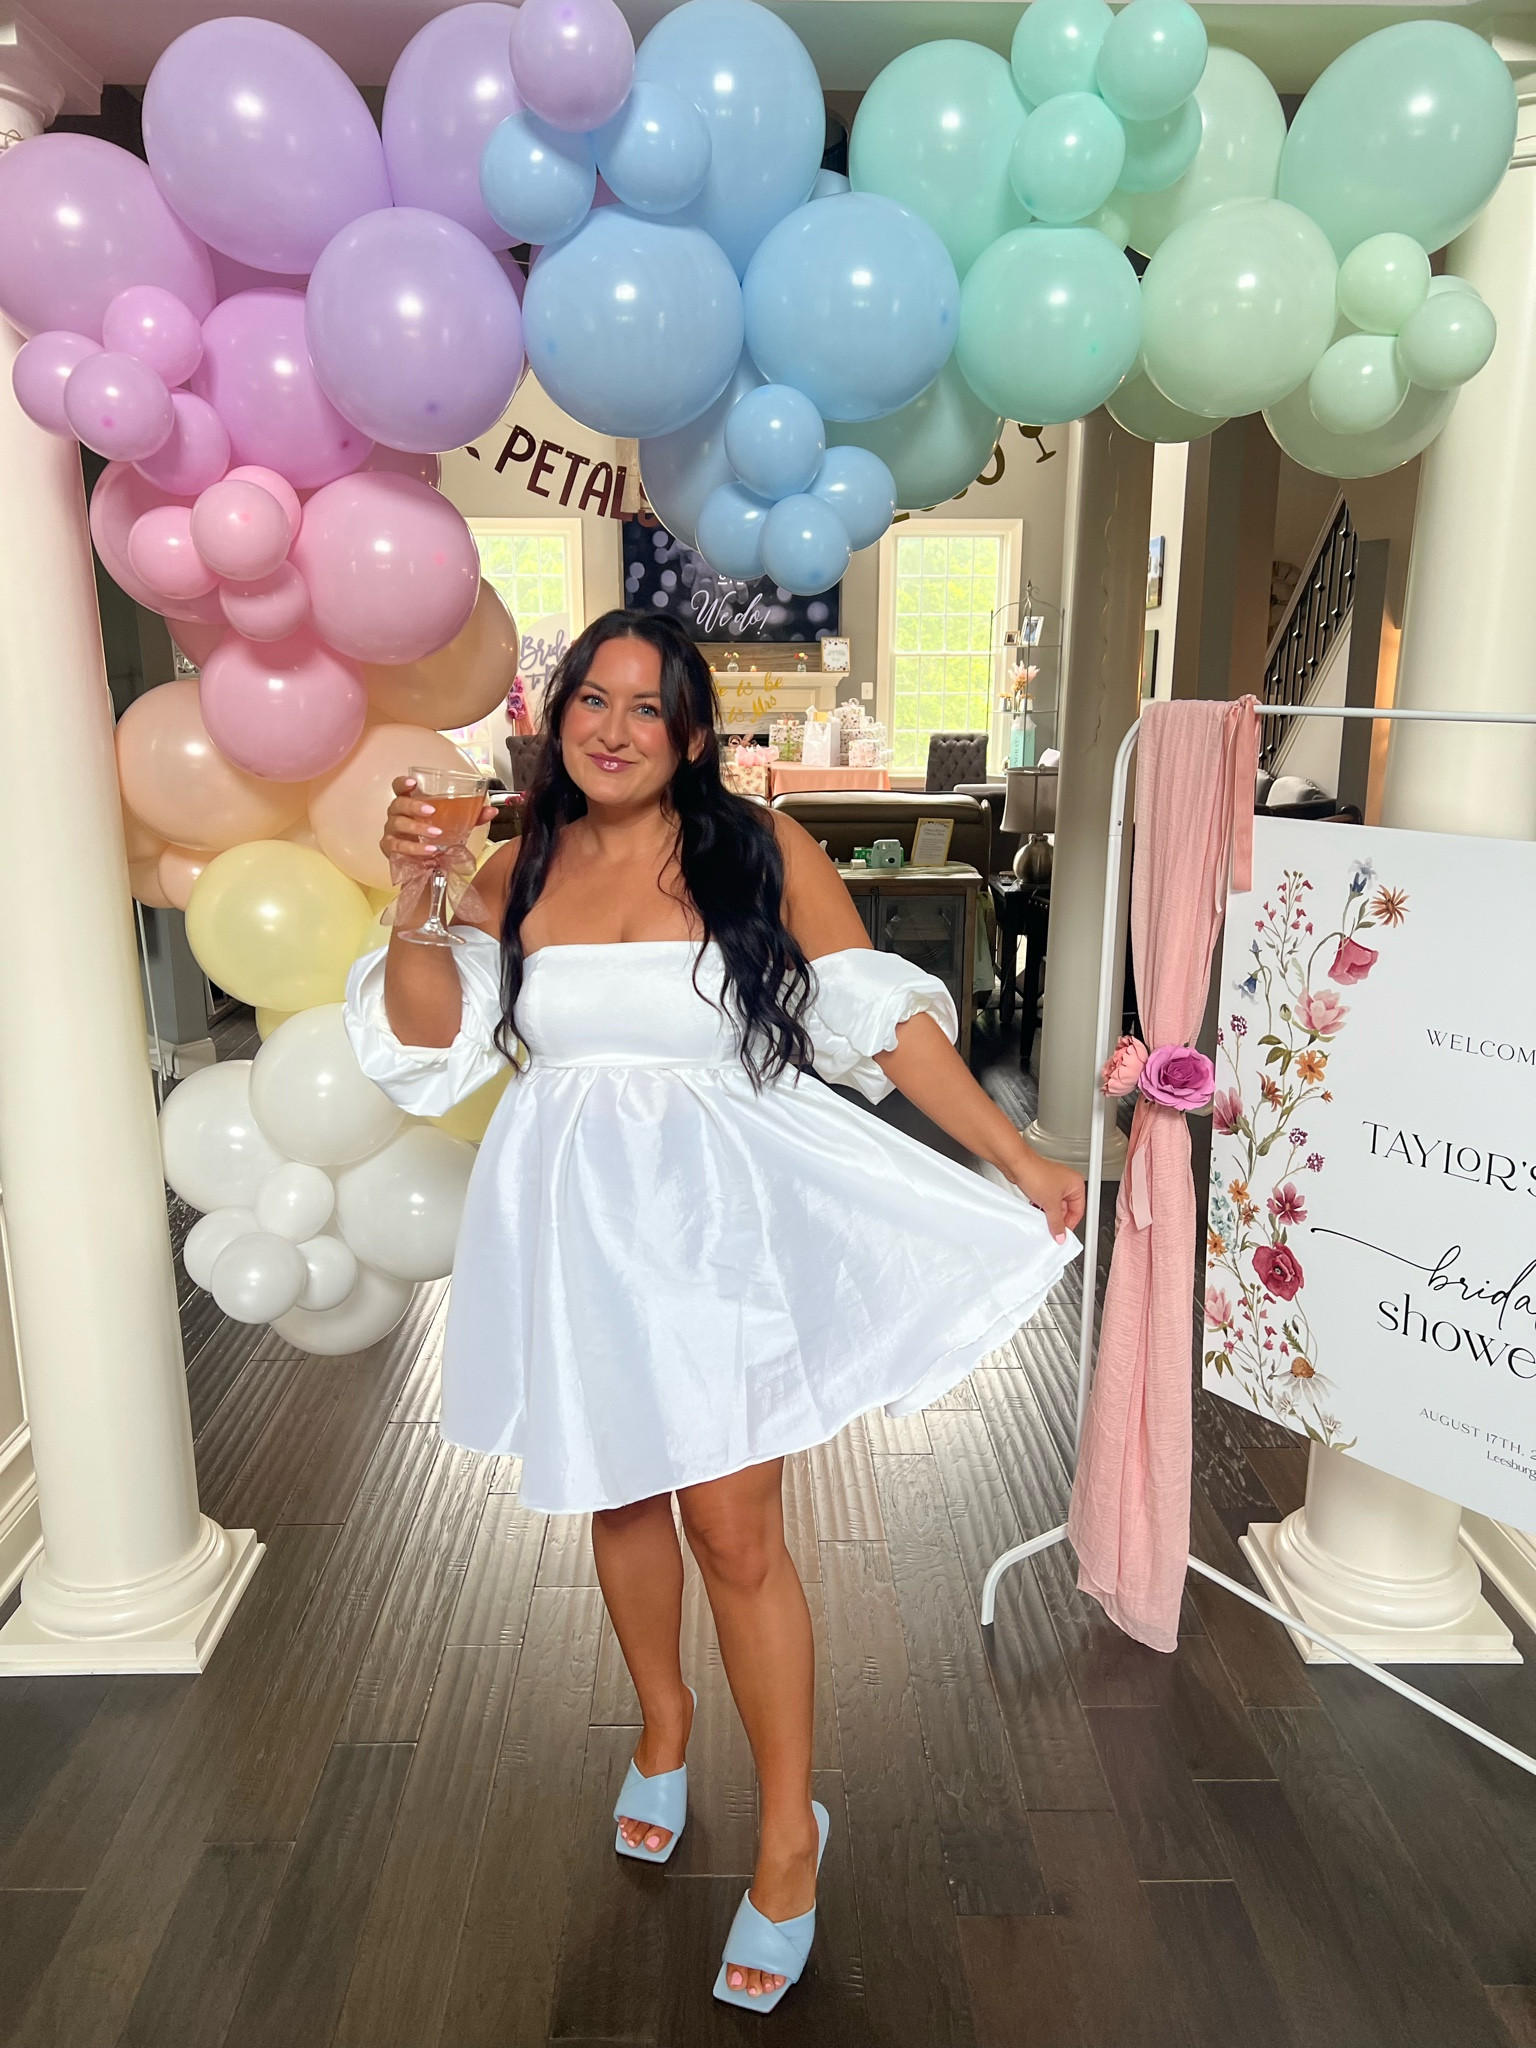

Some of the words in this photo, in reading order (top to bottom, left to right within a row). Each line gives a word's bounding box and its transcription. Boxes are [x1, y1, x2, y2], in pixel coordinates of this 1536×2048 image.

[519, 629, 568, 671] Bride
[750, 695, 777, 724] Mrs
[1426, 1028, 1536, 1066] WELCOM
[1377, 1293, 1536, 1379] showe
[1418, 1408, 1481, 1438] AUGUST
[1486, 1450, 1536, 1481] Leesburg
